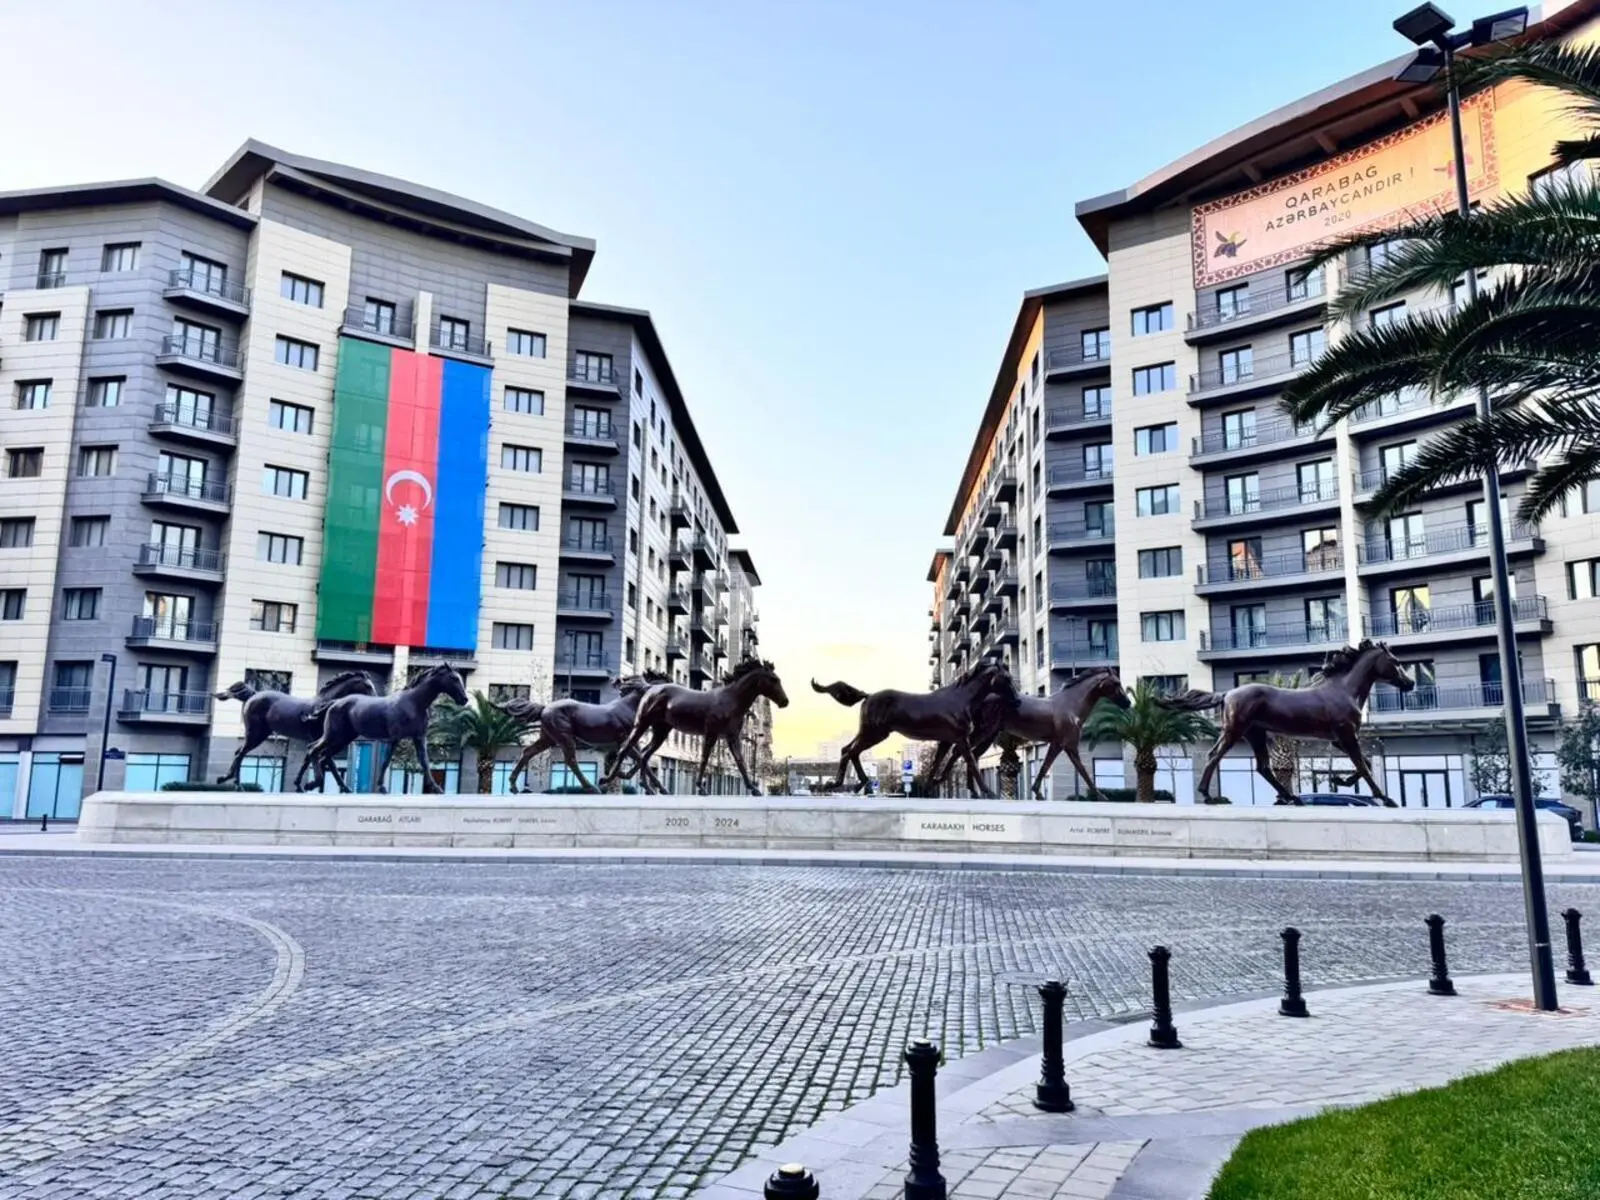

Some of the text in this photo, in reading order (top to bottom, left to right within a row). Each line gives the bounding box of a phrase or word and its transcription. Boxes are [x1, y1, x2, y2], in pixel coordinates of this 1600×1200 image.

[1324, 210, 1352, 227] 2020
[665, 817, 739, 828] 2020 2024
[920, 822, 1006, 832] KARABAKH HORSES
